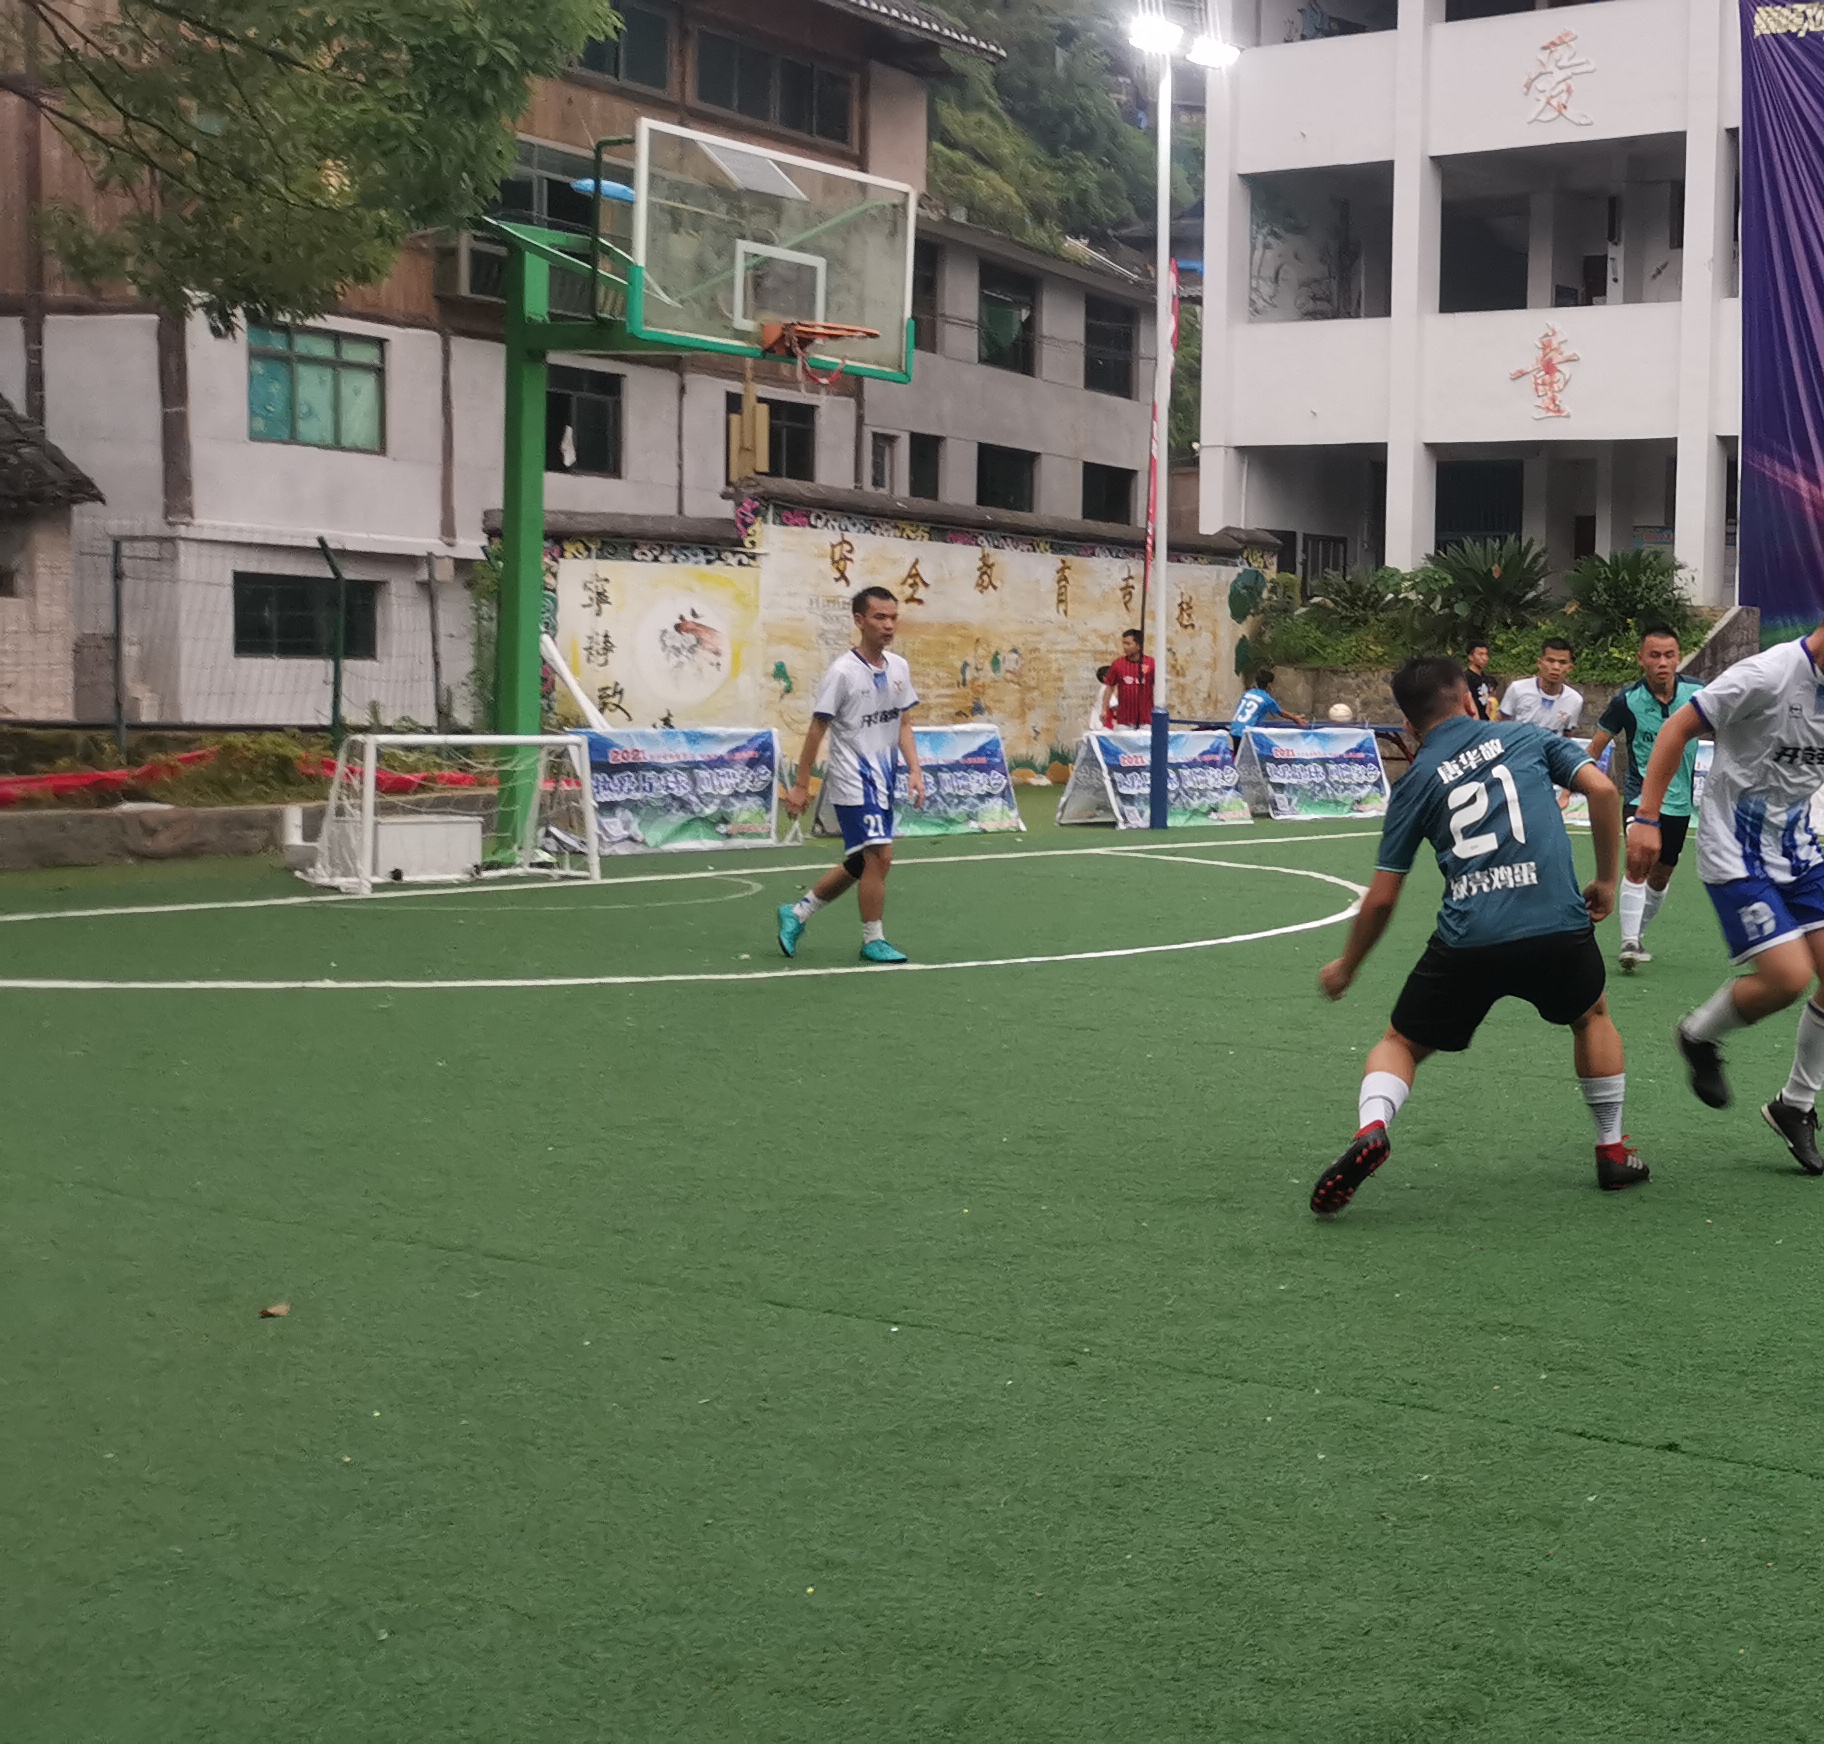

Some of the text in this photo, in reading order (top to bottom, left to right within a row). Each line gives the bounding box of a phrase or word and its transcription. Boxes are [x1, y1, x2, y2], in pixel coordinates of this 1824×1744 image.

[1509, 320, 1580, 420] 童
[863, 814, 886, 838] 21
[1448, 764, 1526, 859] 21
